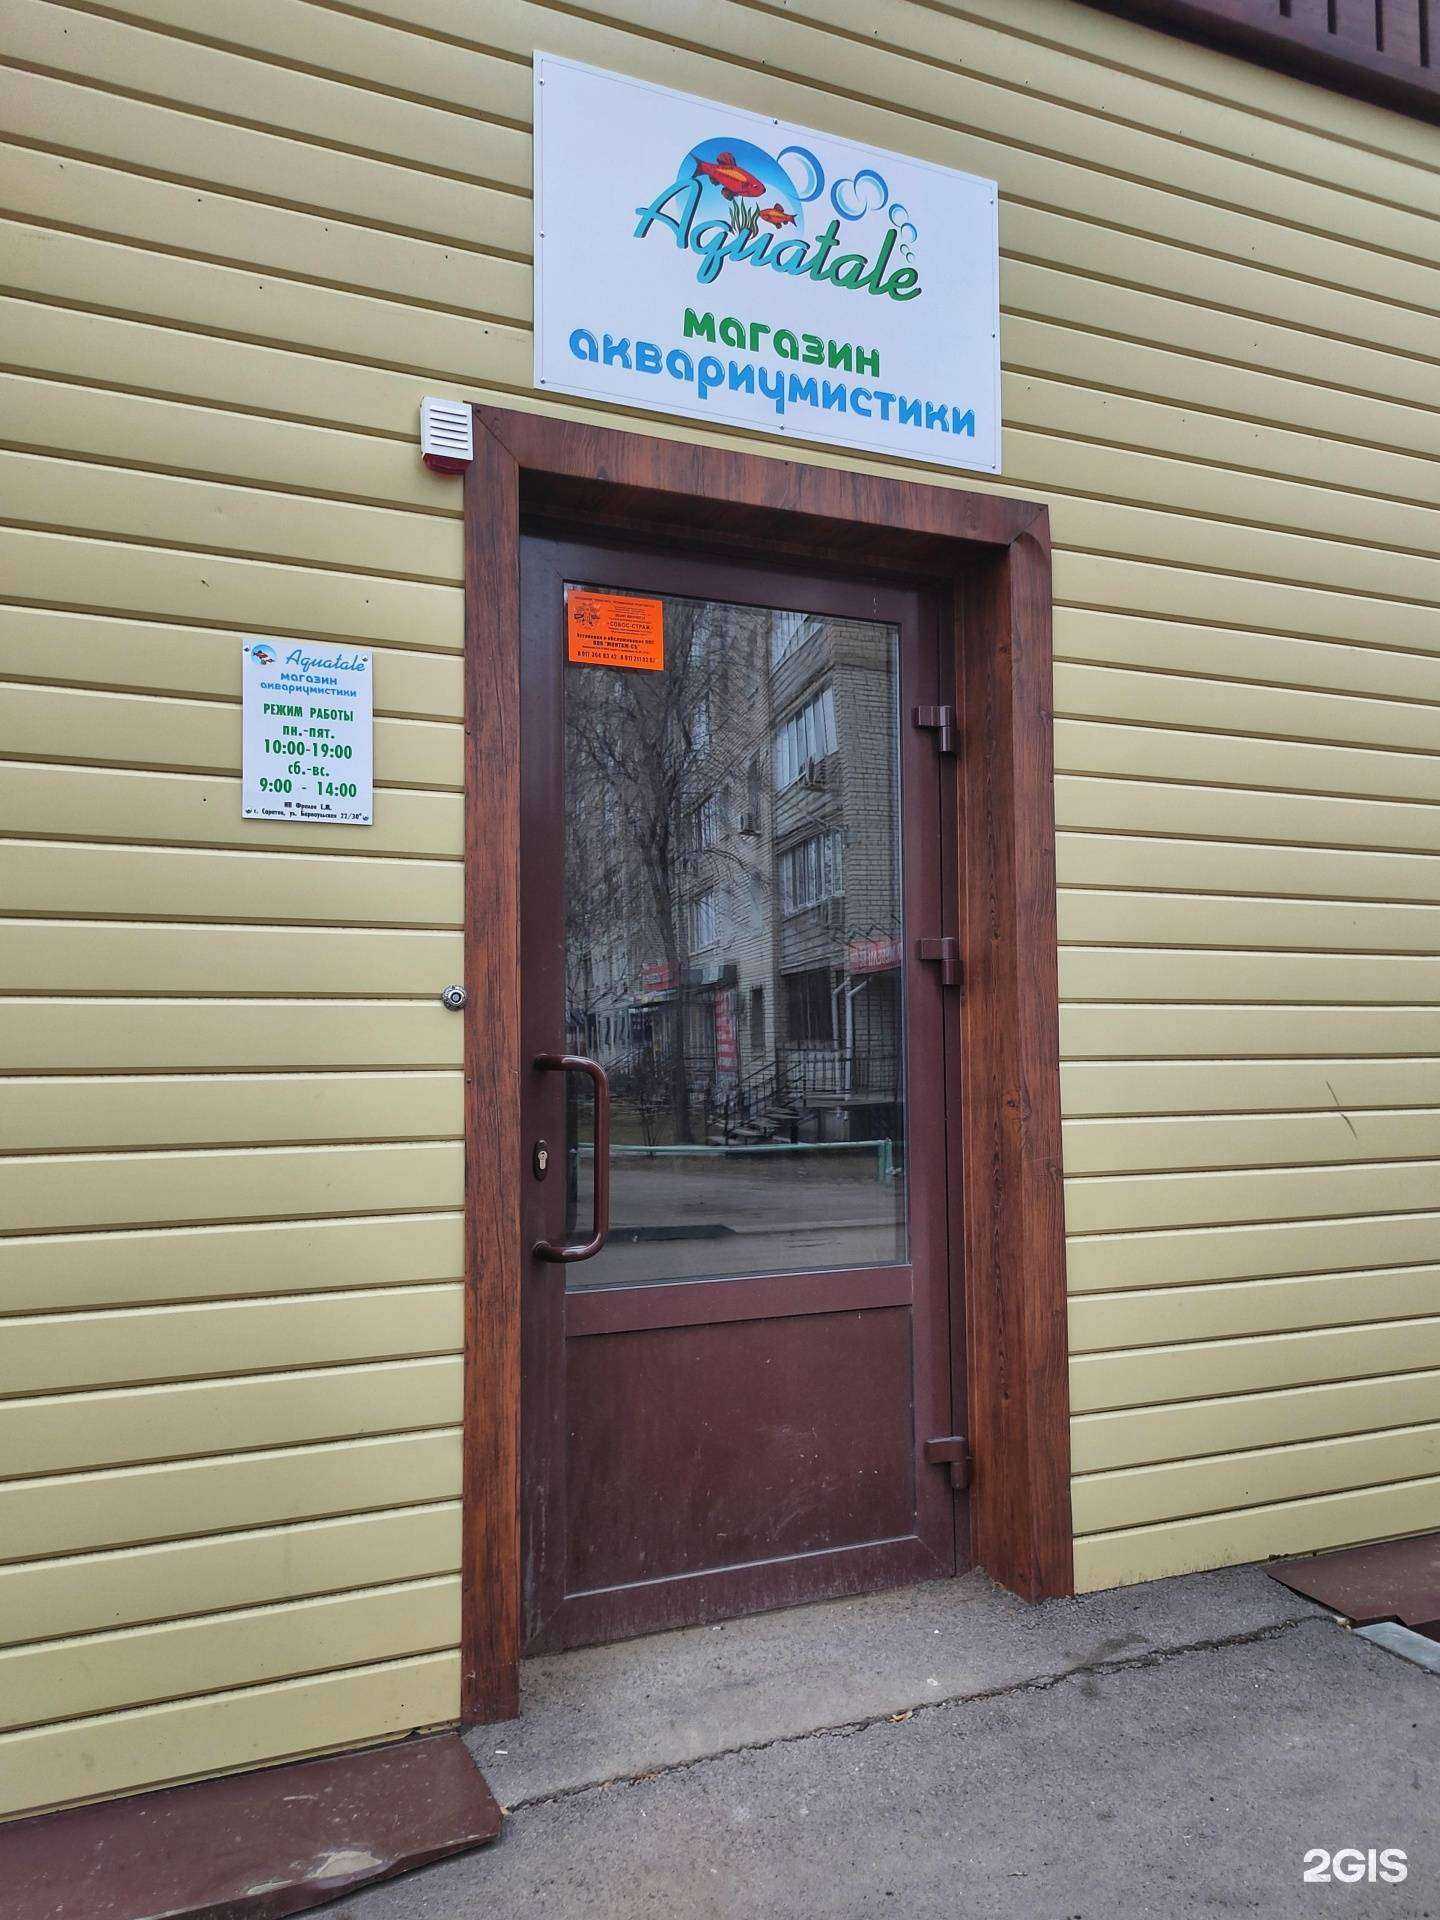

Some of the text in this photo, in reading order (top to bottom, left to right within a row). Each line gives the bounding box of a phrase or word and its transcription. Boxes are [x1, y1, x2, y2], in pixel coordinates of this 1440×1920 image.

[633, 179, 921, 302] Aquatale
[683, 307, 880, 378] магазин
[569, 328, 976, 437] аквариумистики
[286, 649, 366, 672] Aquatale
[280, 673, 338, 686] магазин
[260, 682, 357, 697] аквариумистики
[263, 703, 354, 722] РЕЖИМ РАБОТЫ
[282, 725, 335, 739] пн.-пят.
[264, 739, 353, 759] 10:00-19:00
[288, 761, 330, 777] сб.-вс.
[259, 778, 292, 793] 9:00
[317, 781, 357, 797] 14:00
